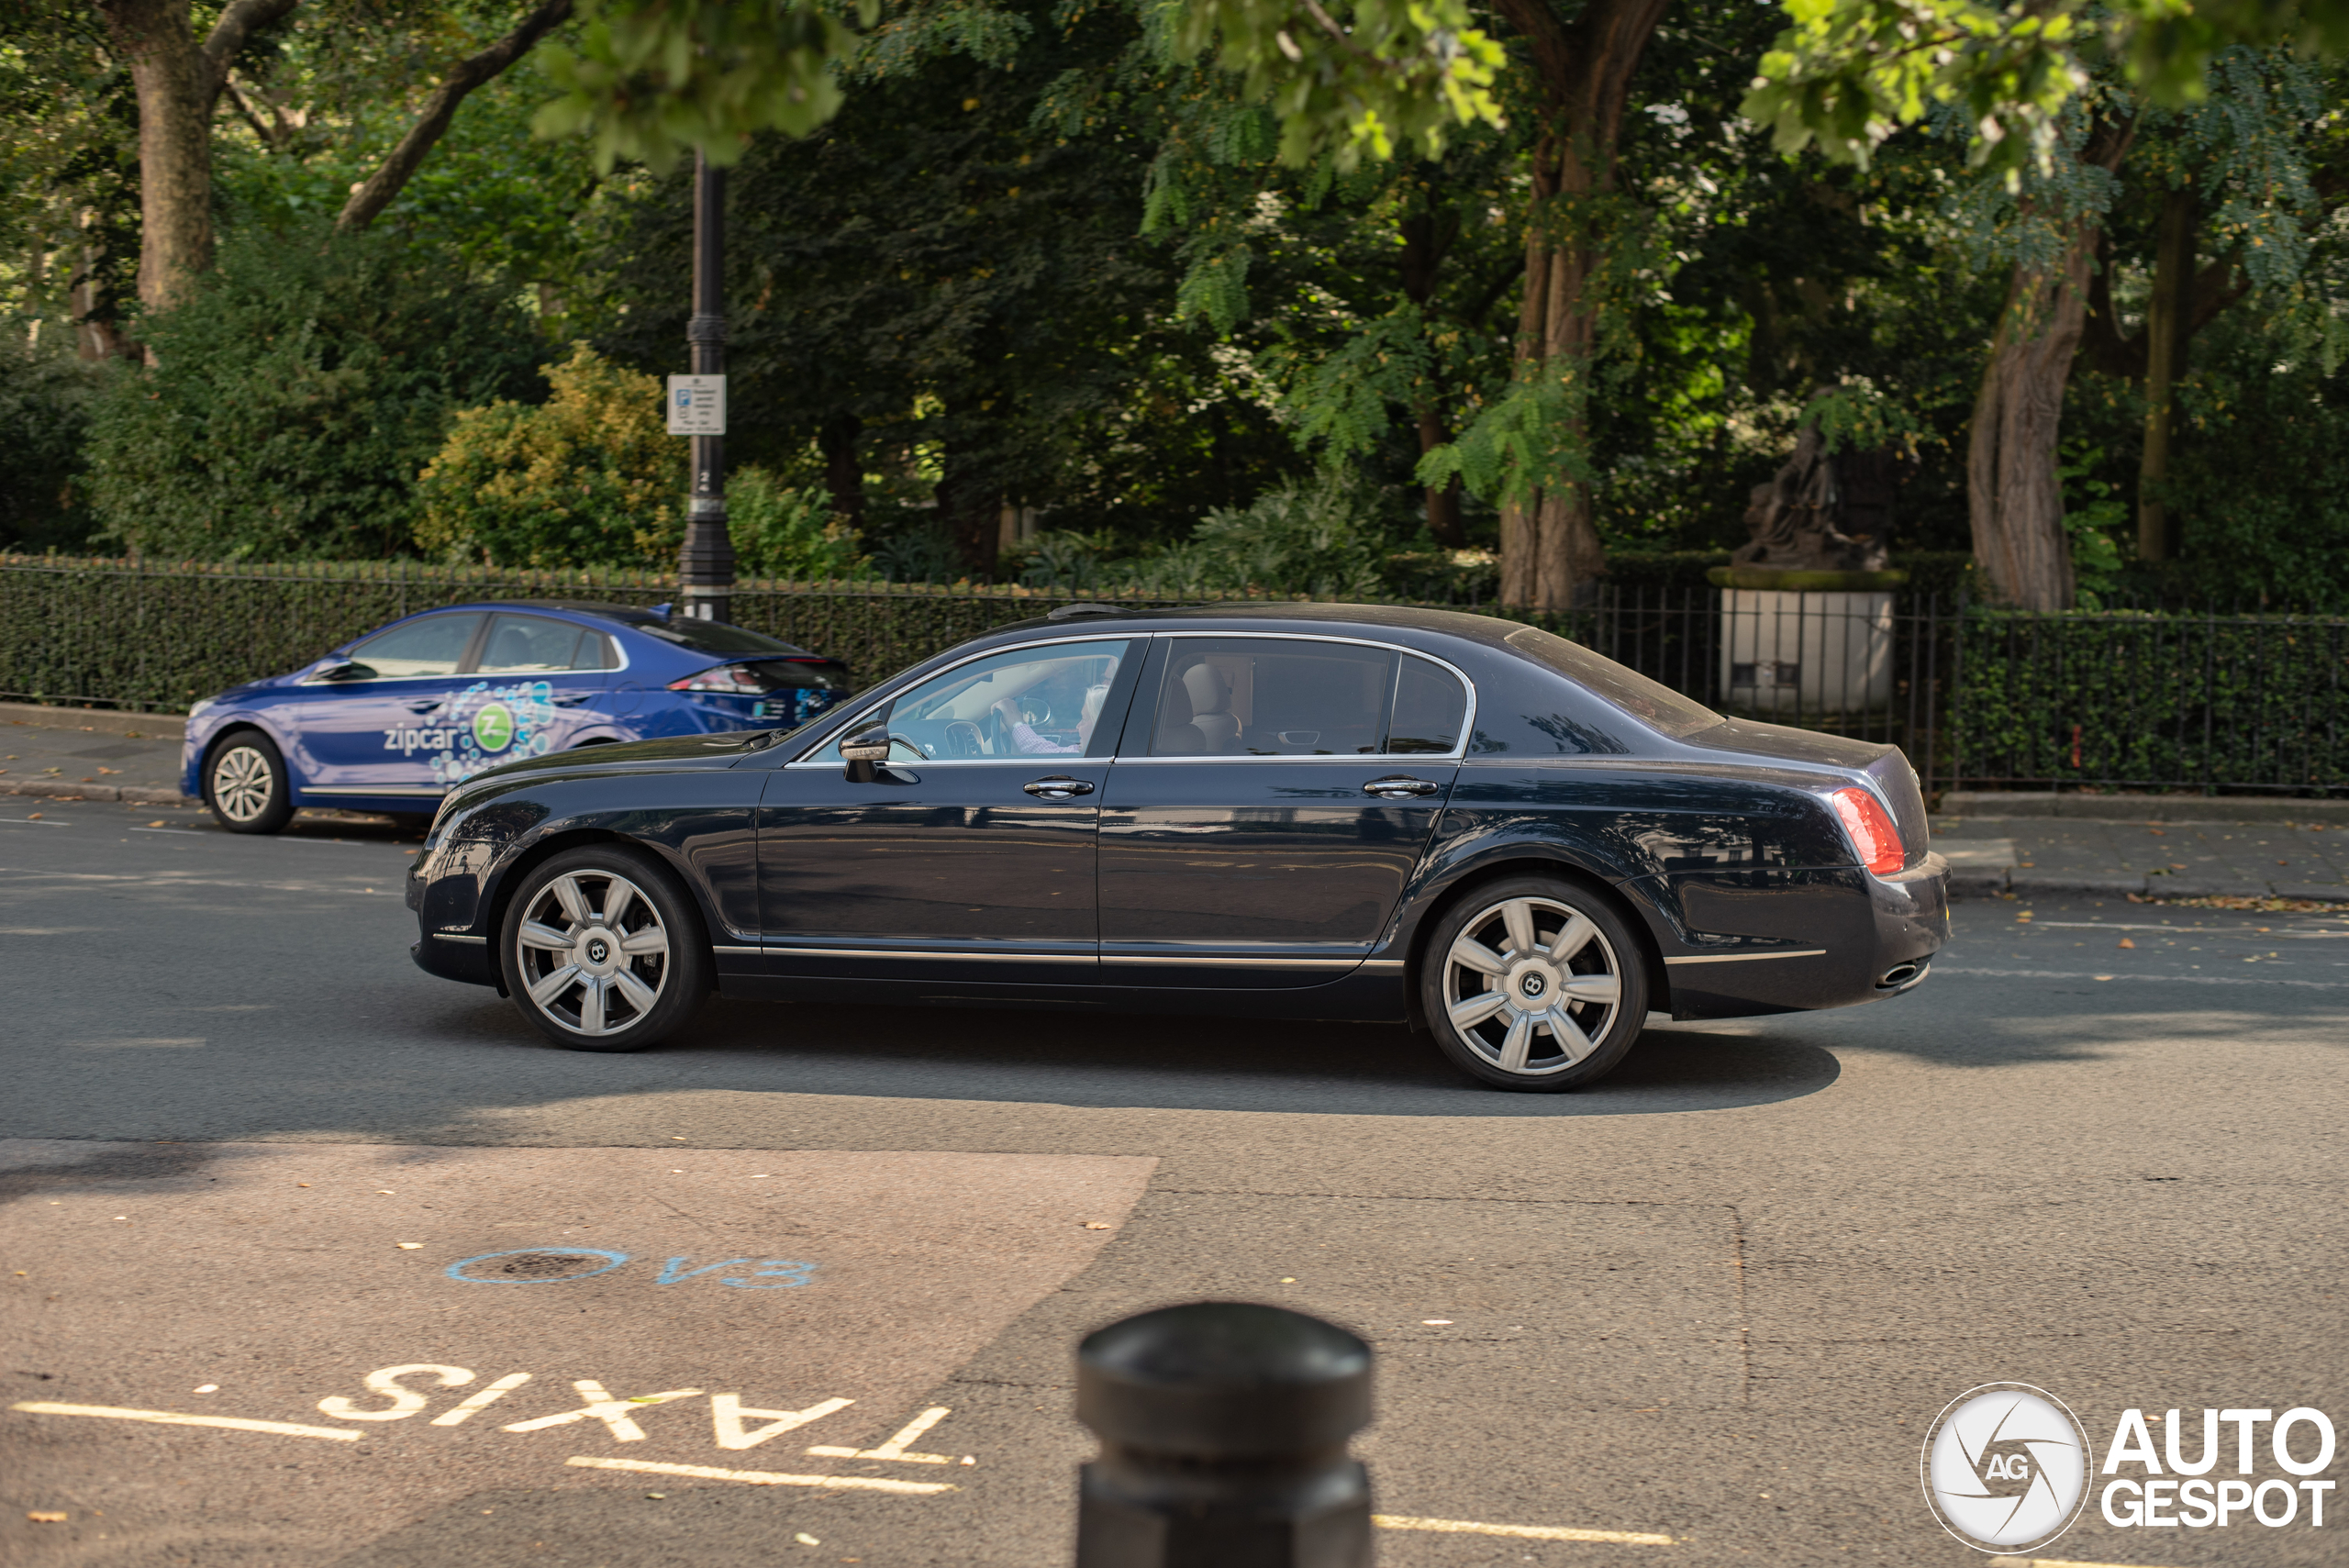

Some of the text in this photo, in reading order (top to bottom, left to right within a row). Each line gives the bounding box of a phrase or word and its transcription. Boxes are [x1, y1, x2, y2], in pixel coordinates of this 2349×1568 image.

[678, 390, 688, 405] P
[384, 722, 459, 757] zipcar
[1525, 977, 1542, 995] B
[656, 1256, 817, 1289] V3
[317, 1362, 952, 1464] TAXIS
